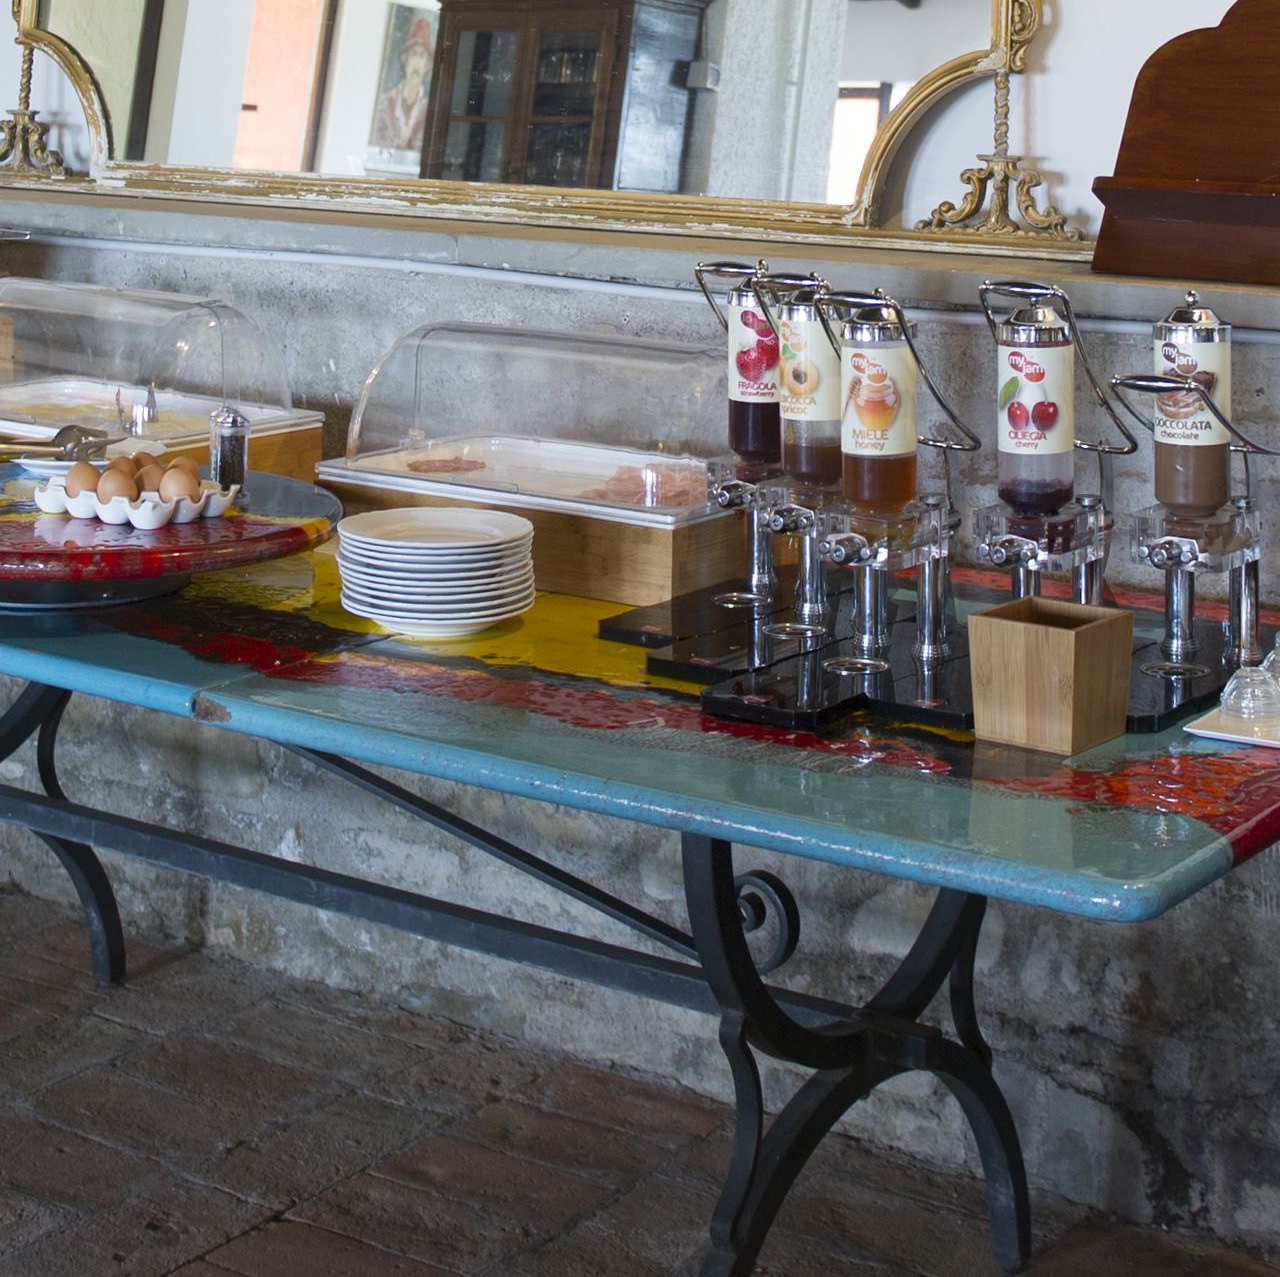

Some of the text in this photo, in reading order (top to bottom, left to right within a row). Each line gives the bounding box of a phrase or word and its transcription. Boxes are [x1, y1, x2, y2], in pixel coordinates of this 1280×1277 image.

[1161, 347, 1196, 365] my jam
[852, 358, 887, 377] my jam
[1009, 355, 1044, 374] my jam
[738, 381, 777, 391] FRAGOLA
[782, 405, 809, 415] pricot
[852, 428, 889, 440] MIELE
[1008, 430, 1048, 441] CILIEGIA
[1160, 430, 1200, 440] chocolate
[855, 439, 886, 451] honey
[1015, 441, 1039, 450] cherry
